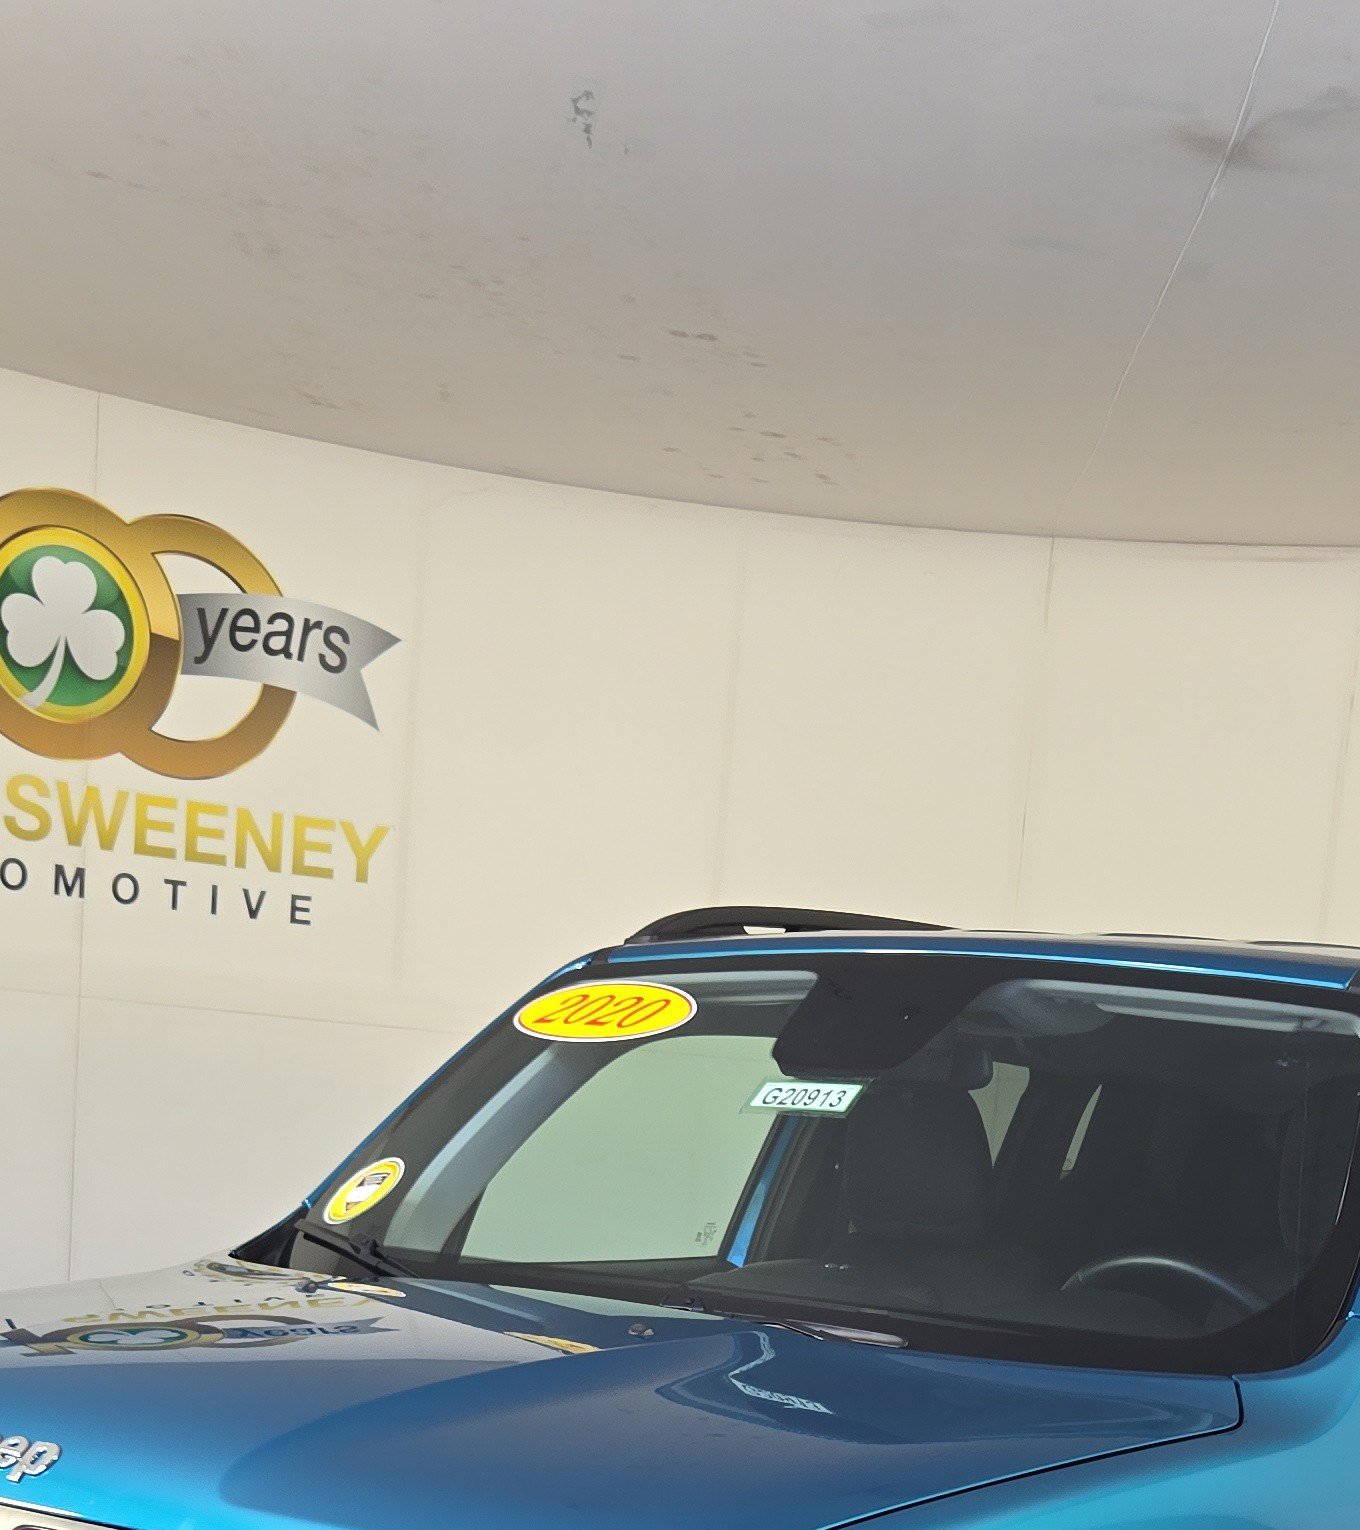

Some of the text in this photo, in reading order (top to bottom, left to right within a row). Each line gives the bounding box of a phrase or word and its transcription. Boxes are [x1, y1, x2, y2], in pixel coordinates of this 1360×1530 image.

[194, 605, 351, 675] years
[3, 773, 390, 885] SWEENEY
[532, 994, 672, 1029] 2020
[762, 1087, 847, 1108] G20913
